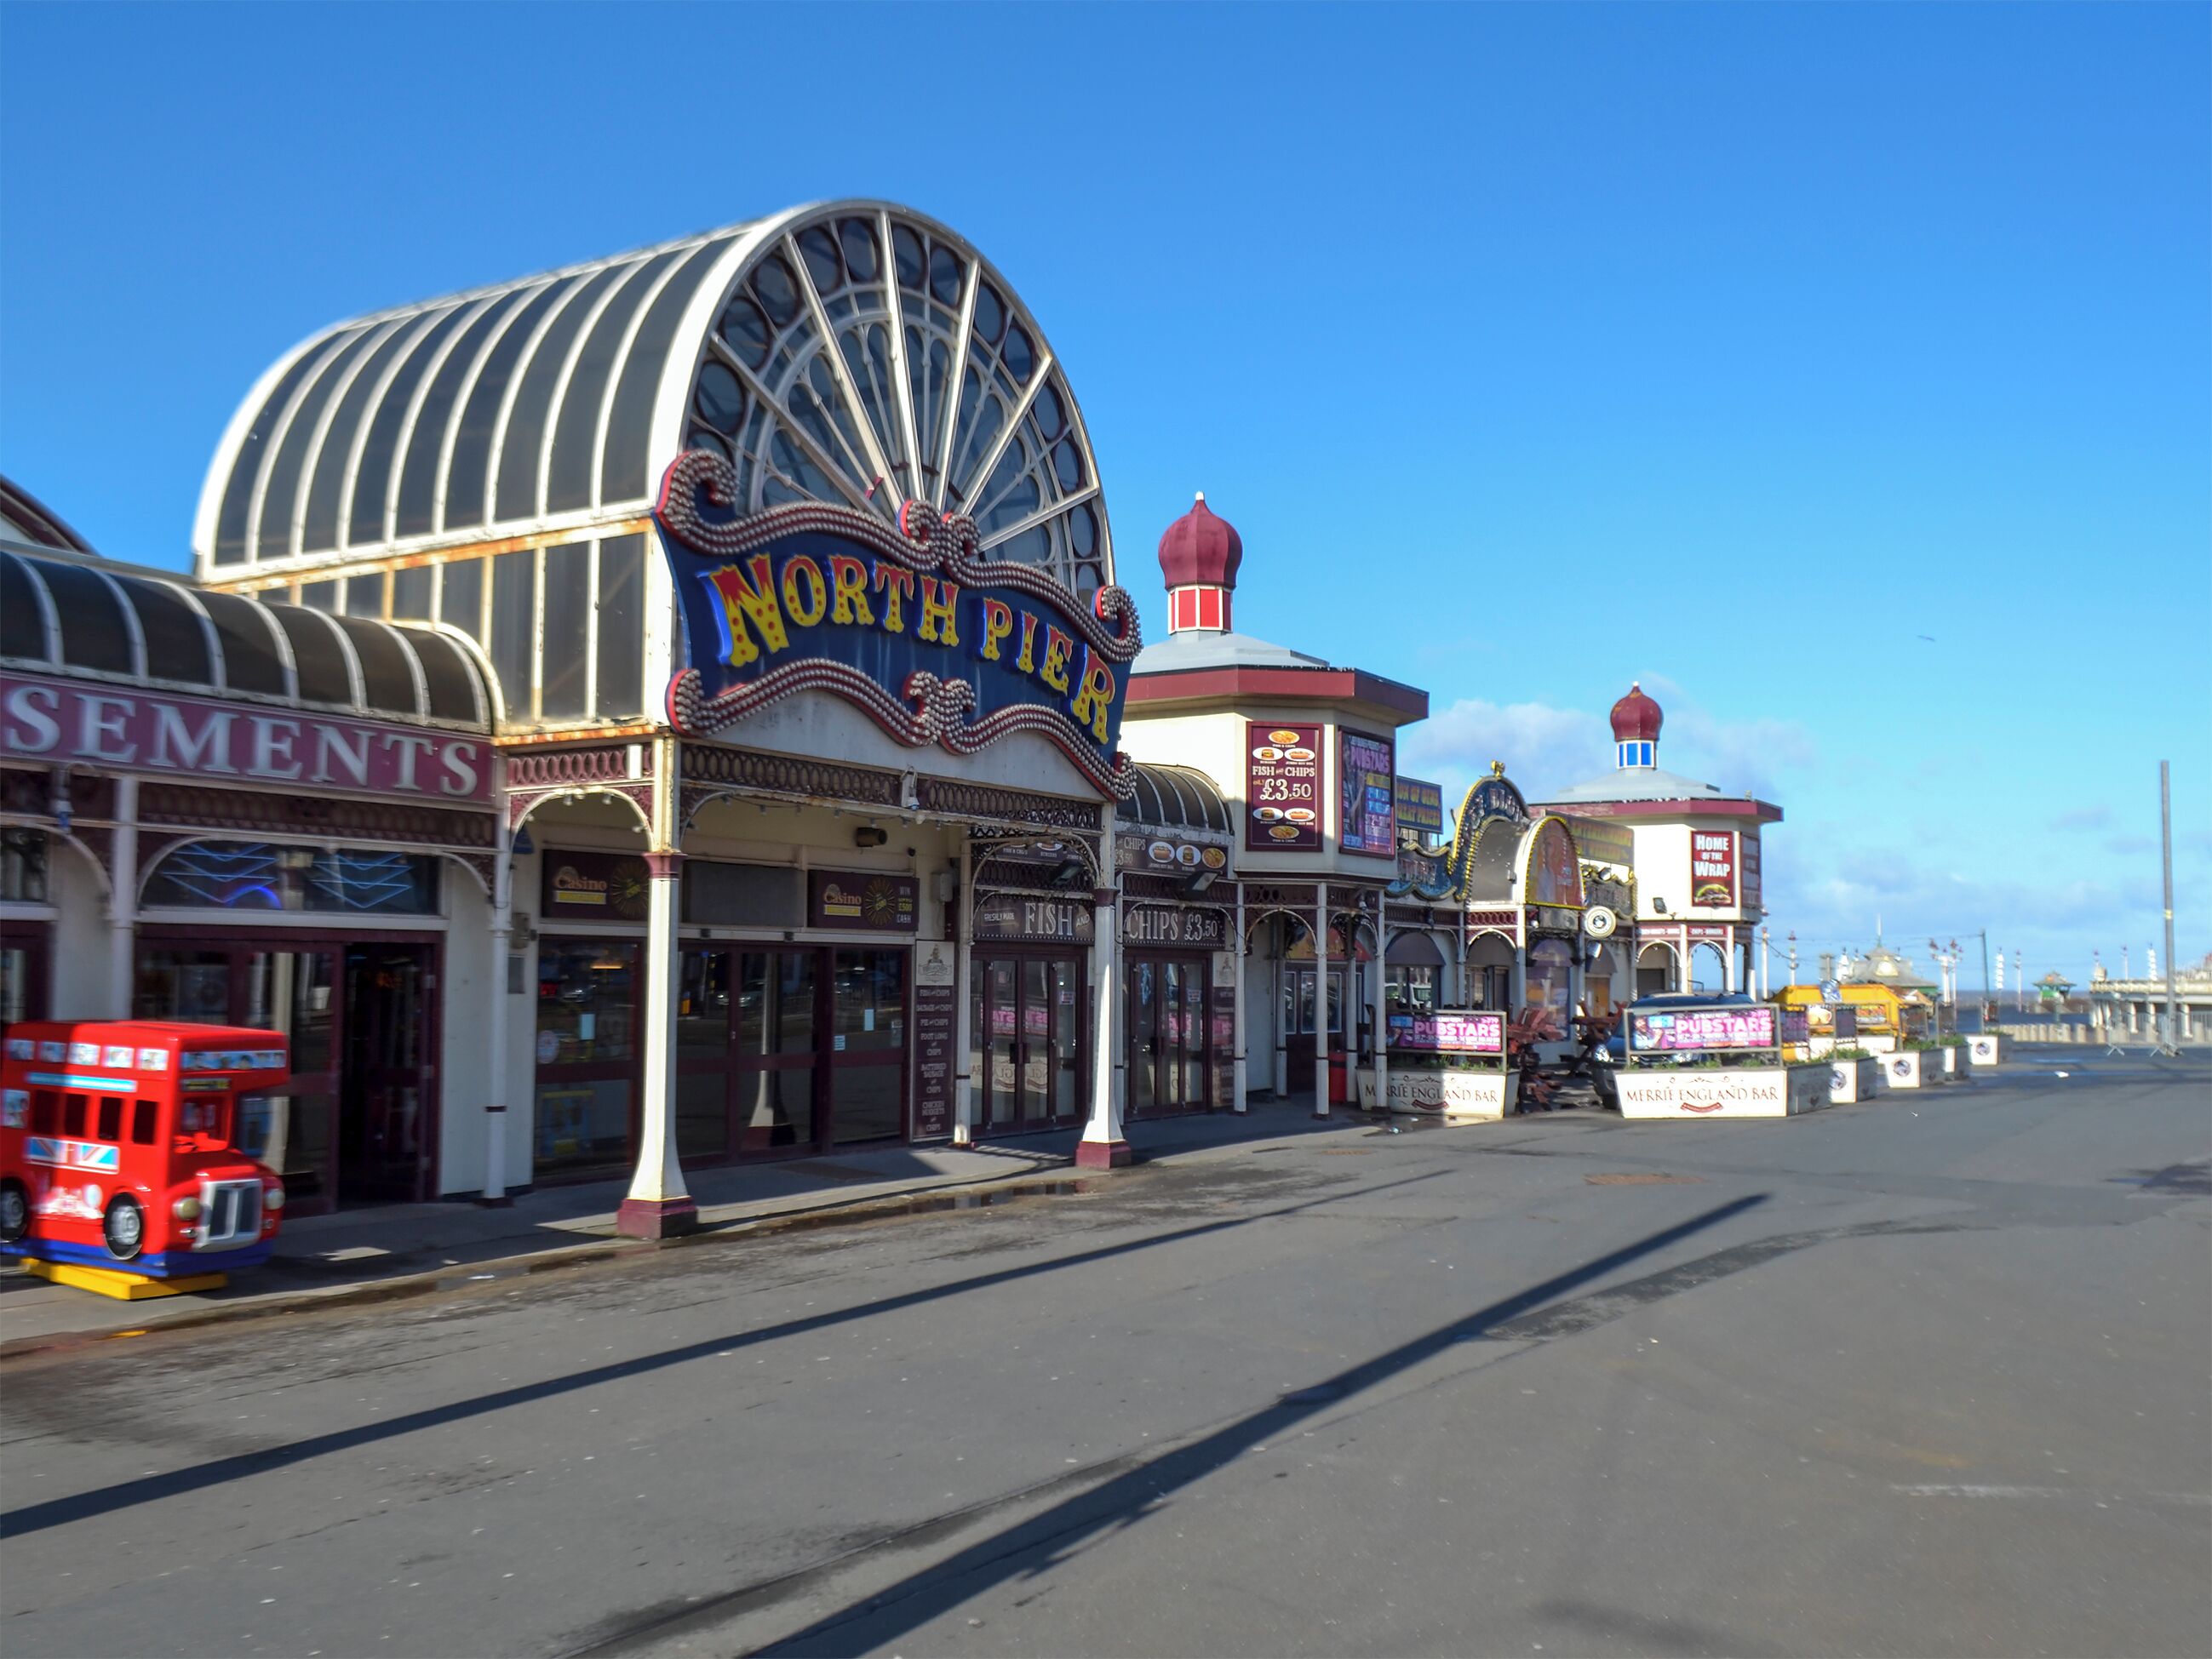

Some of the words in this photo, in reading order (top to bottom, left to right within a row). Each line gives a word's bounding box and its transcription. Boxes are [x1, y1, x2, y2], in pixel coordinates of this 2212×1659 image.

[707, 552, 960, 667] NORTH
[981, 597, 1115, 745] PIER
[5, 686, 479, 797] SEMENTS
[1252, 766, 1275, 775] FISH
[1285, 767, 1315, 776] CHIPS
[1260, 778, 1312, 800] £3.50
[1124, 837, 1146, 850] CHIPS
[1695, 835, 1729, 851] HOME
[1694, 861, 1731, 878] WRAP
[556, 875, 607, 891] Casino
[823, 892, 862, 905] Casino
[1024, 902, 1073, 935] FISH
[1126, 909, 1178, 941] CHIPS
[1184, 914, 1218, 941] £3.50
[1414, 1021, 1500, 1038] PUBSTARS
[1676, 1018, 1771, 1033] PUBSTARS
[1365, 1084, 1408, 1098] MRRIE
[1412, 1087, 1471, 1101] ENGLAND
[1475, 1090, 1498, 1102] BAR
[1627, 1089, 1674, 1101] MERRIE
[1679, 1087, 1748, 1101] ENGLAND
[1752, 1086, 1779, 1100] BAR
